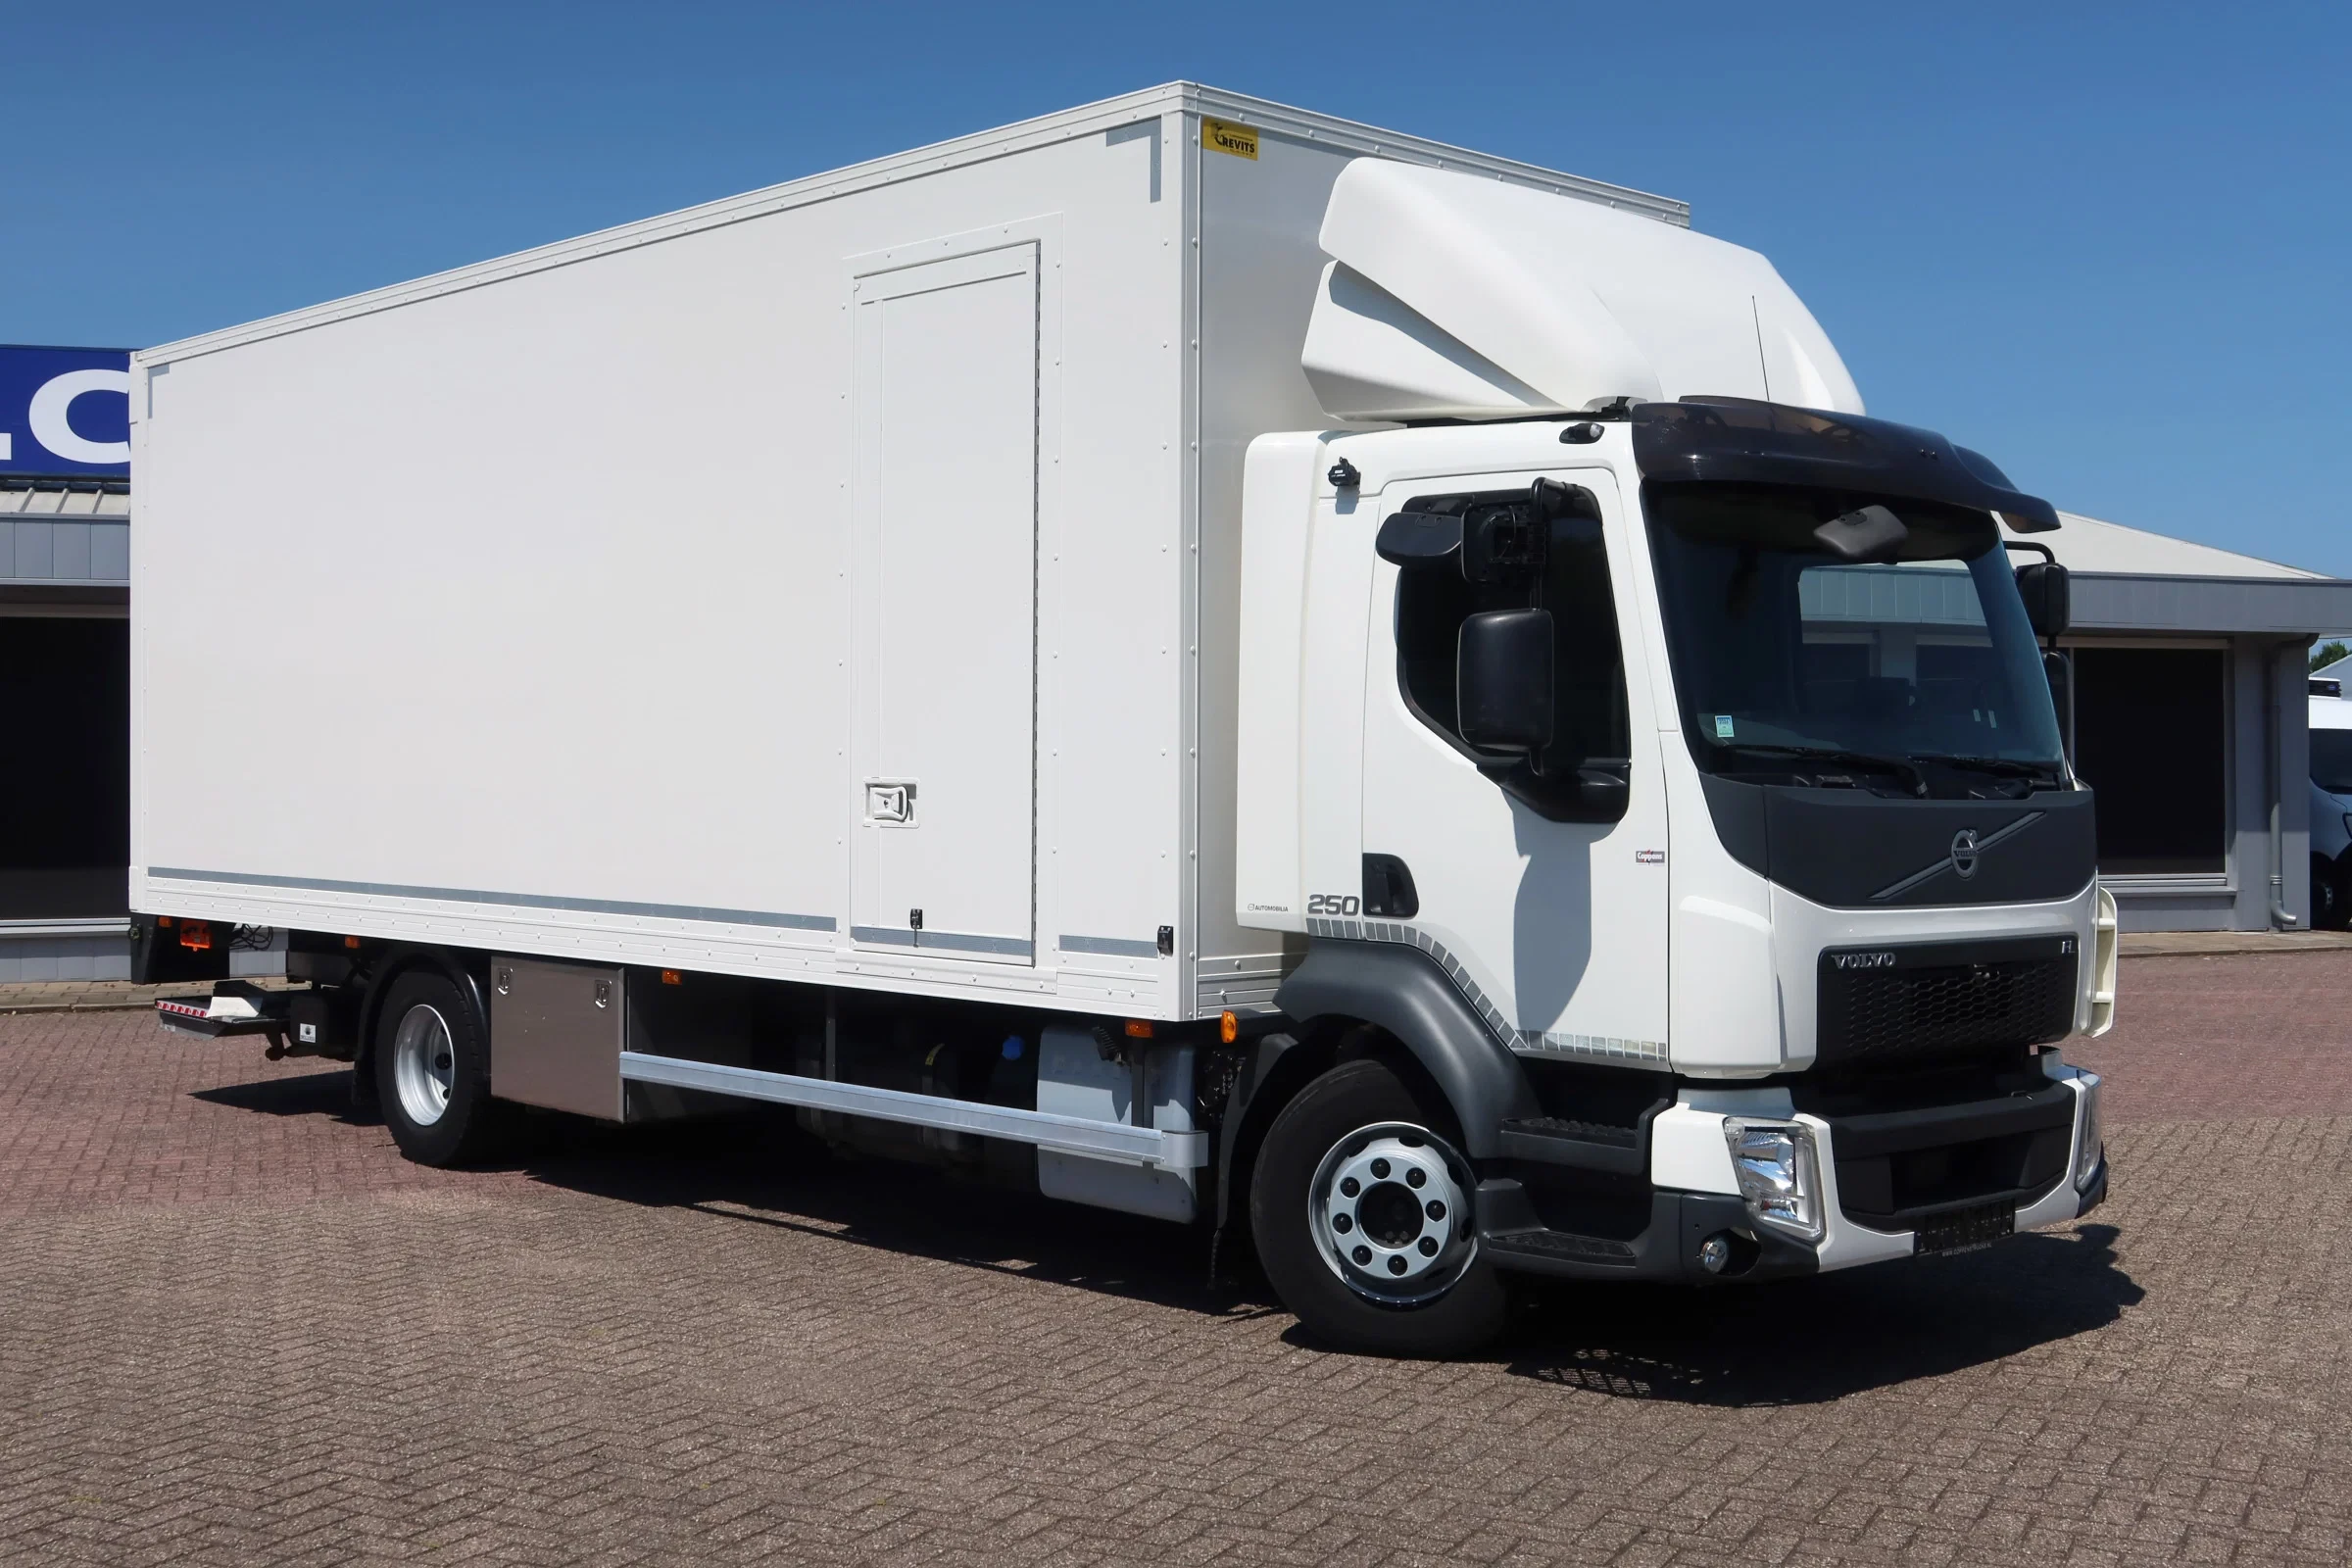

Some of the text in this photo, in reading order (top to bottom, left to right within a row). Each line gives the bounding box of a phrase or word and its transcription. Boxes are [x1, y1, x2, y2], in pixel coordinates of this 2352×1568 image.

[1637, 852, 1663, 861] Coppens
[1307, 894, 1360, 916] 250
[1831, 952, 1896, 969] VOLVO
